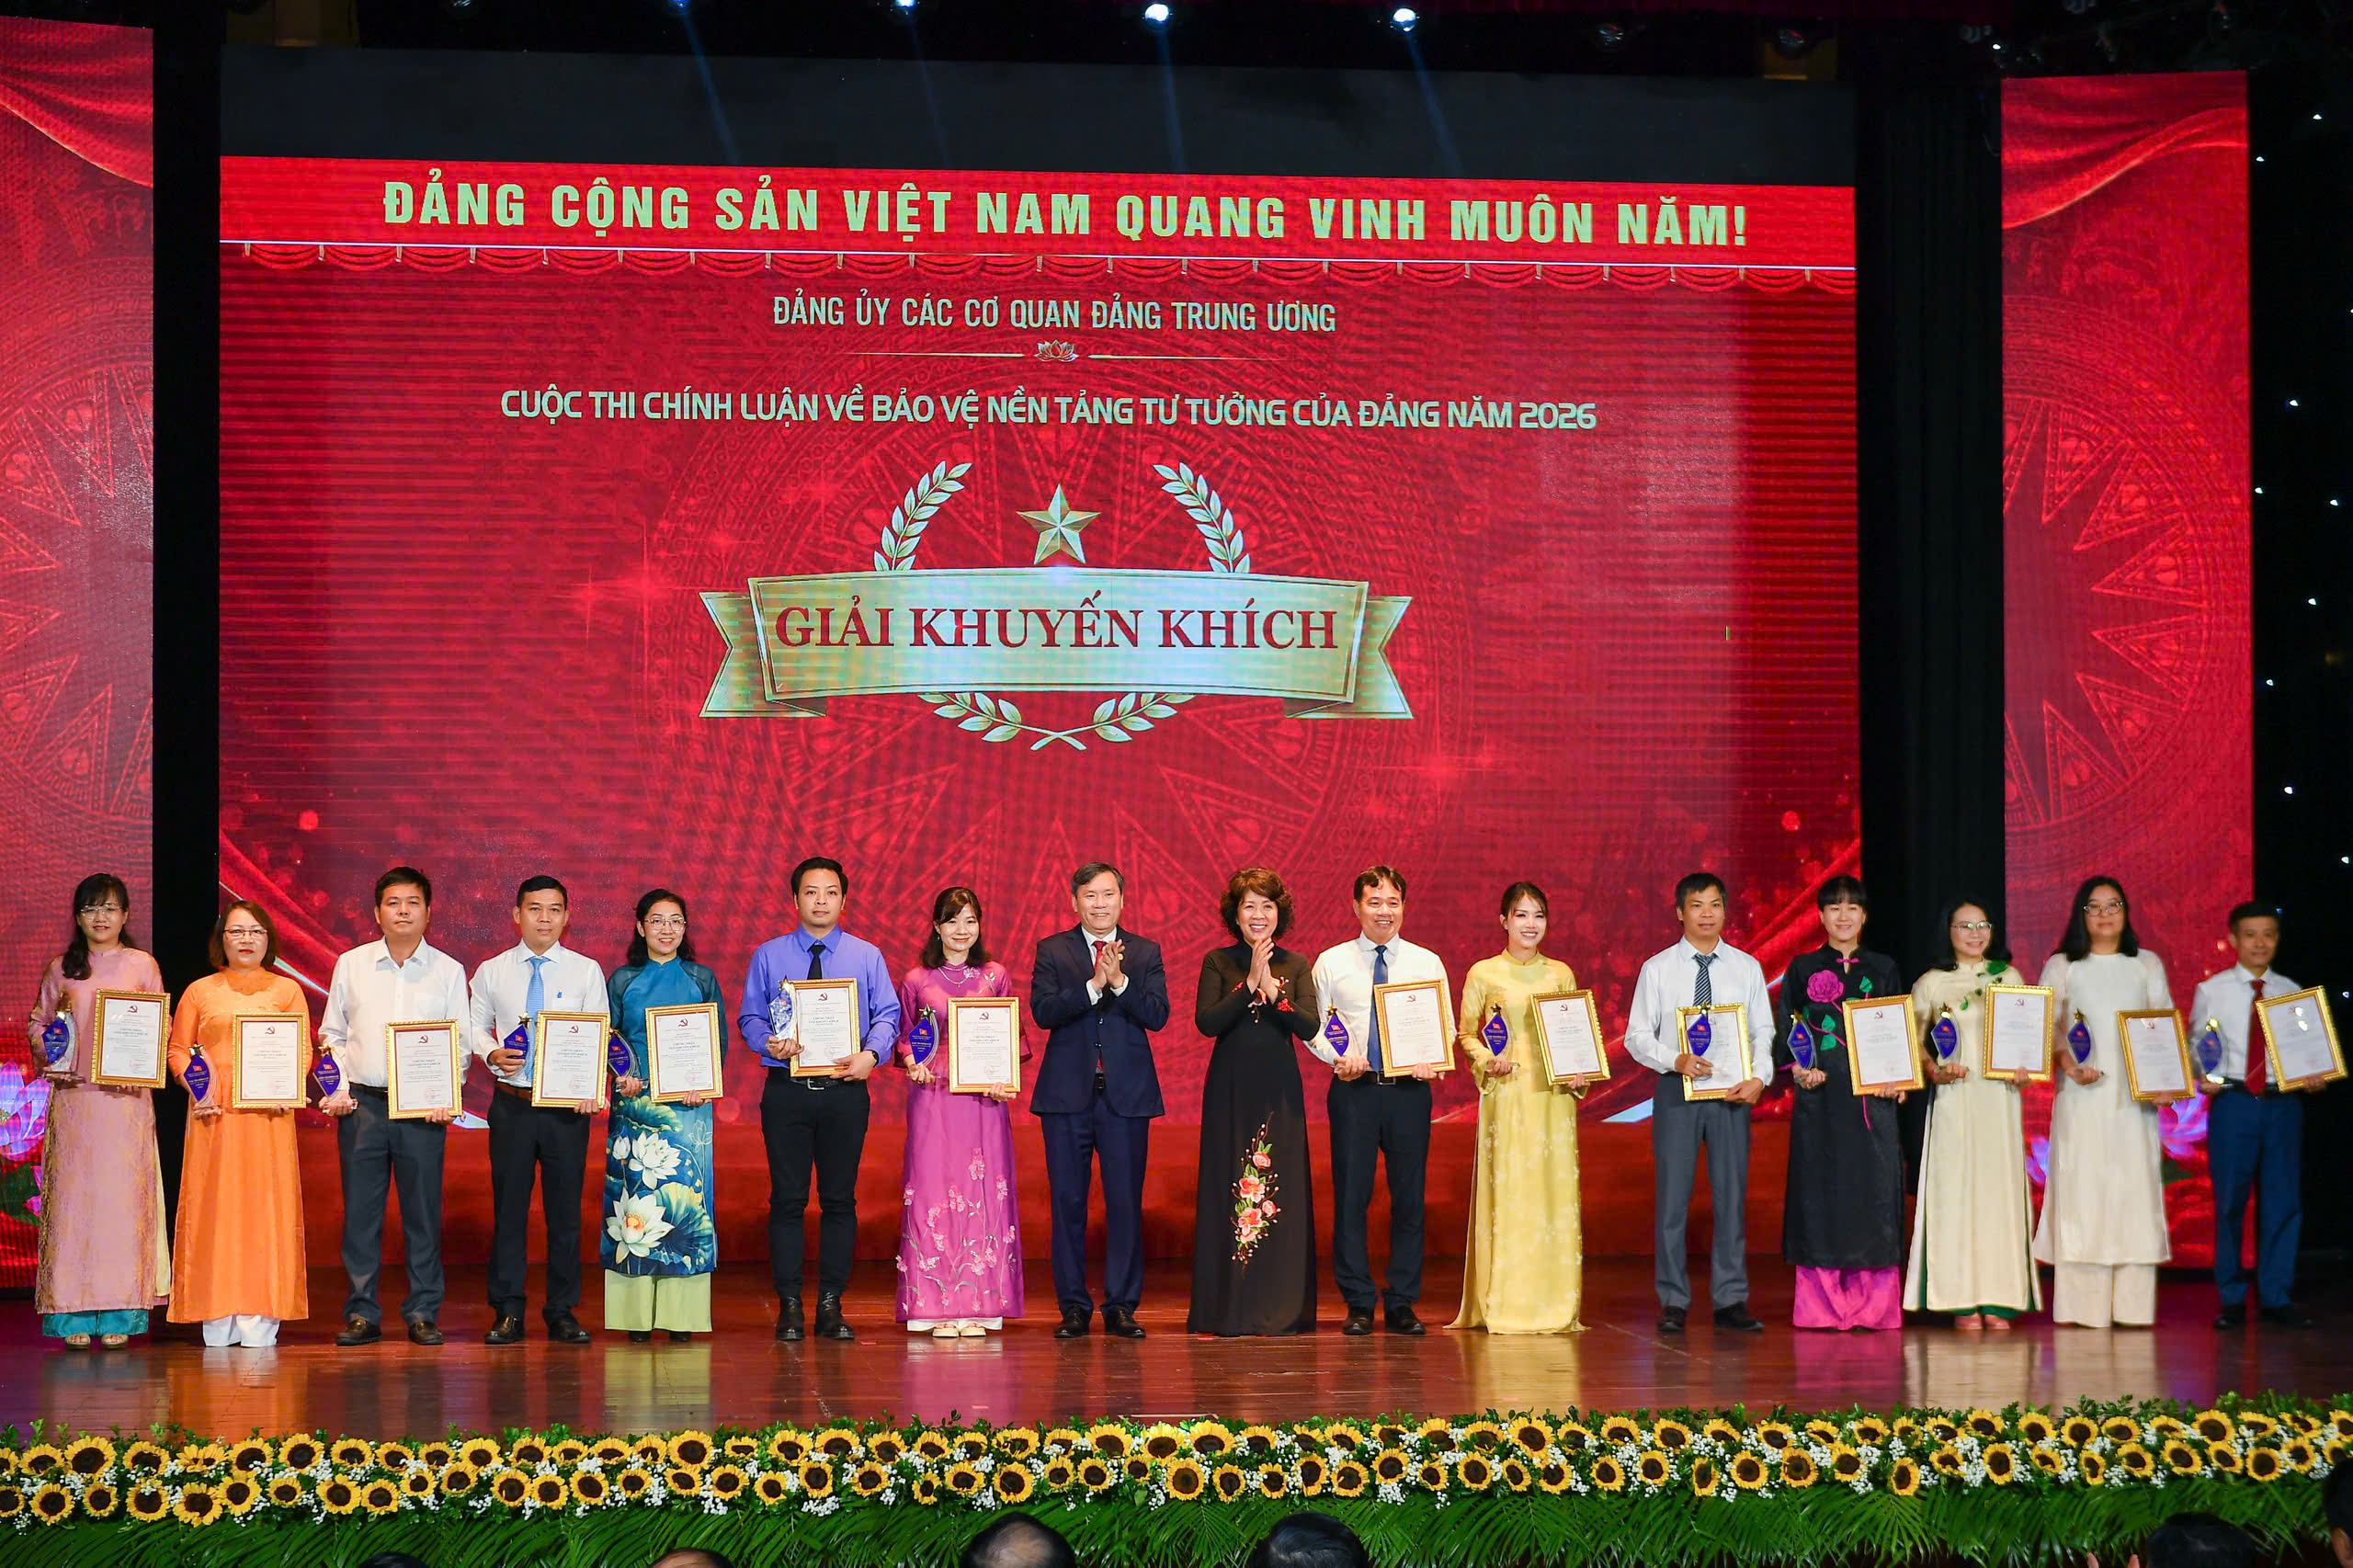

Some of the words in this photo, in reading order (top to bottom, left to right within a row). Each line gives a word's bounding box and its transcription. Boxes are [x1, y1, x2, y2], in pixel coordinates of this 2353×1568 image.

[383, 168, 525, 226] ĐẢNG
[551, 176, 688, 237] CỘNG
[715, 174, 818, 231] SẢN
[842, 182, 951, 243] VIỆT
[976, 192, 1090, 235] NAM
[1116, 195, 1285, 242] QUANG
[1309, 199, 1426, 241] VINH
[1450, 193, 1593, 244] MUÔN
[1617, 195, 1745, 246] NĂM!
[773, 287, 844, 325] ĐẢNG
[856, 288, 890, 326] ỦY
[902, 292, 953, 327] CÁC
[964, 295, 999, 327] CƠ
[1010, 299, 1080, 329] QUAN
[1091, 291, 1162, 330] ĐẢNG
[1170, 301, 1256, 331] TRUNG
[1267, 300, 1336, 333] ƯƠNG
[501, 383, 583, 425] CUỘC
[589, 391, 635, 420] THI
[642, 385, 732, 420] CHÍNH
[740, 386, 819, 428] LUẬN
[824, 382, 865, 422] VỀ
[872, 384, 935, 423] BẢO
[940, 388, 980, 430] VỆ
[987, 382, 1048, 424] NỀN
[1054, 388, 1133, 426] TẢNG
[1140, 394, 1180, 425] TƯ
[1185, 391, 1287, 426] TƯỞNG
[1293, 392, 1352, 428] CỦA
[1358, 392, 1440, 427] ĐẢNG
[1448, 395, 1513, 428] NĂM
[1519, 402, 1597, 430] 2026
[775, 595, 895, 648] GIẢI
[908, 589, 1144, 648] KHUYẾN
[1157, 597, 1339, 650] KHÍCH
